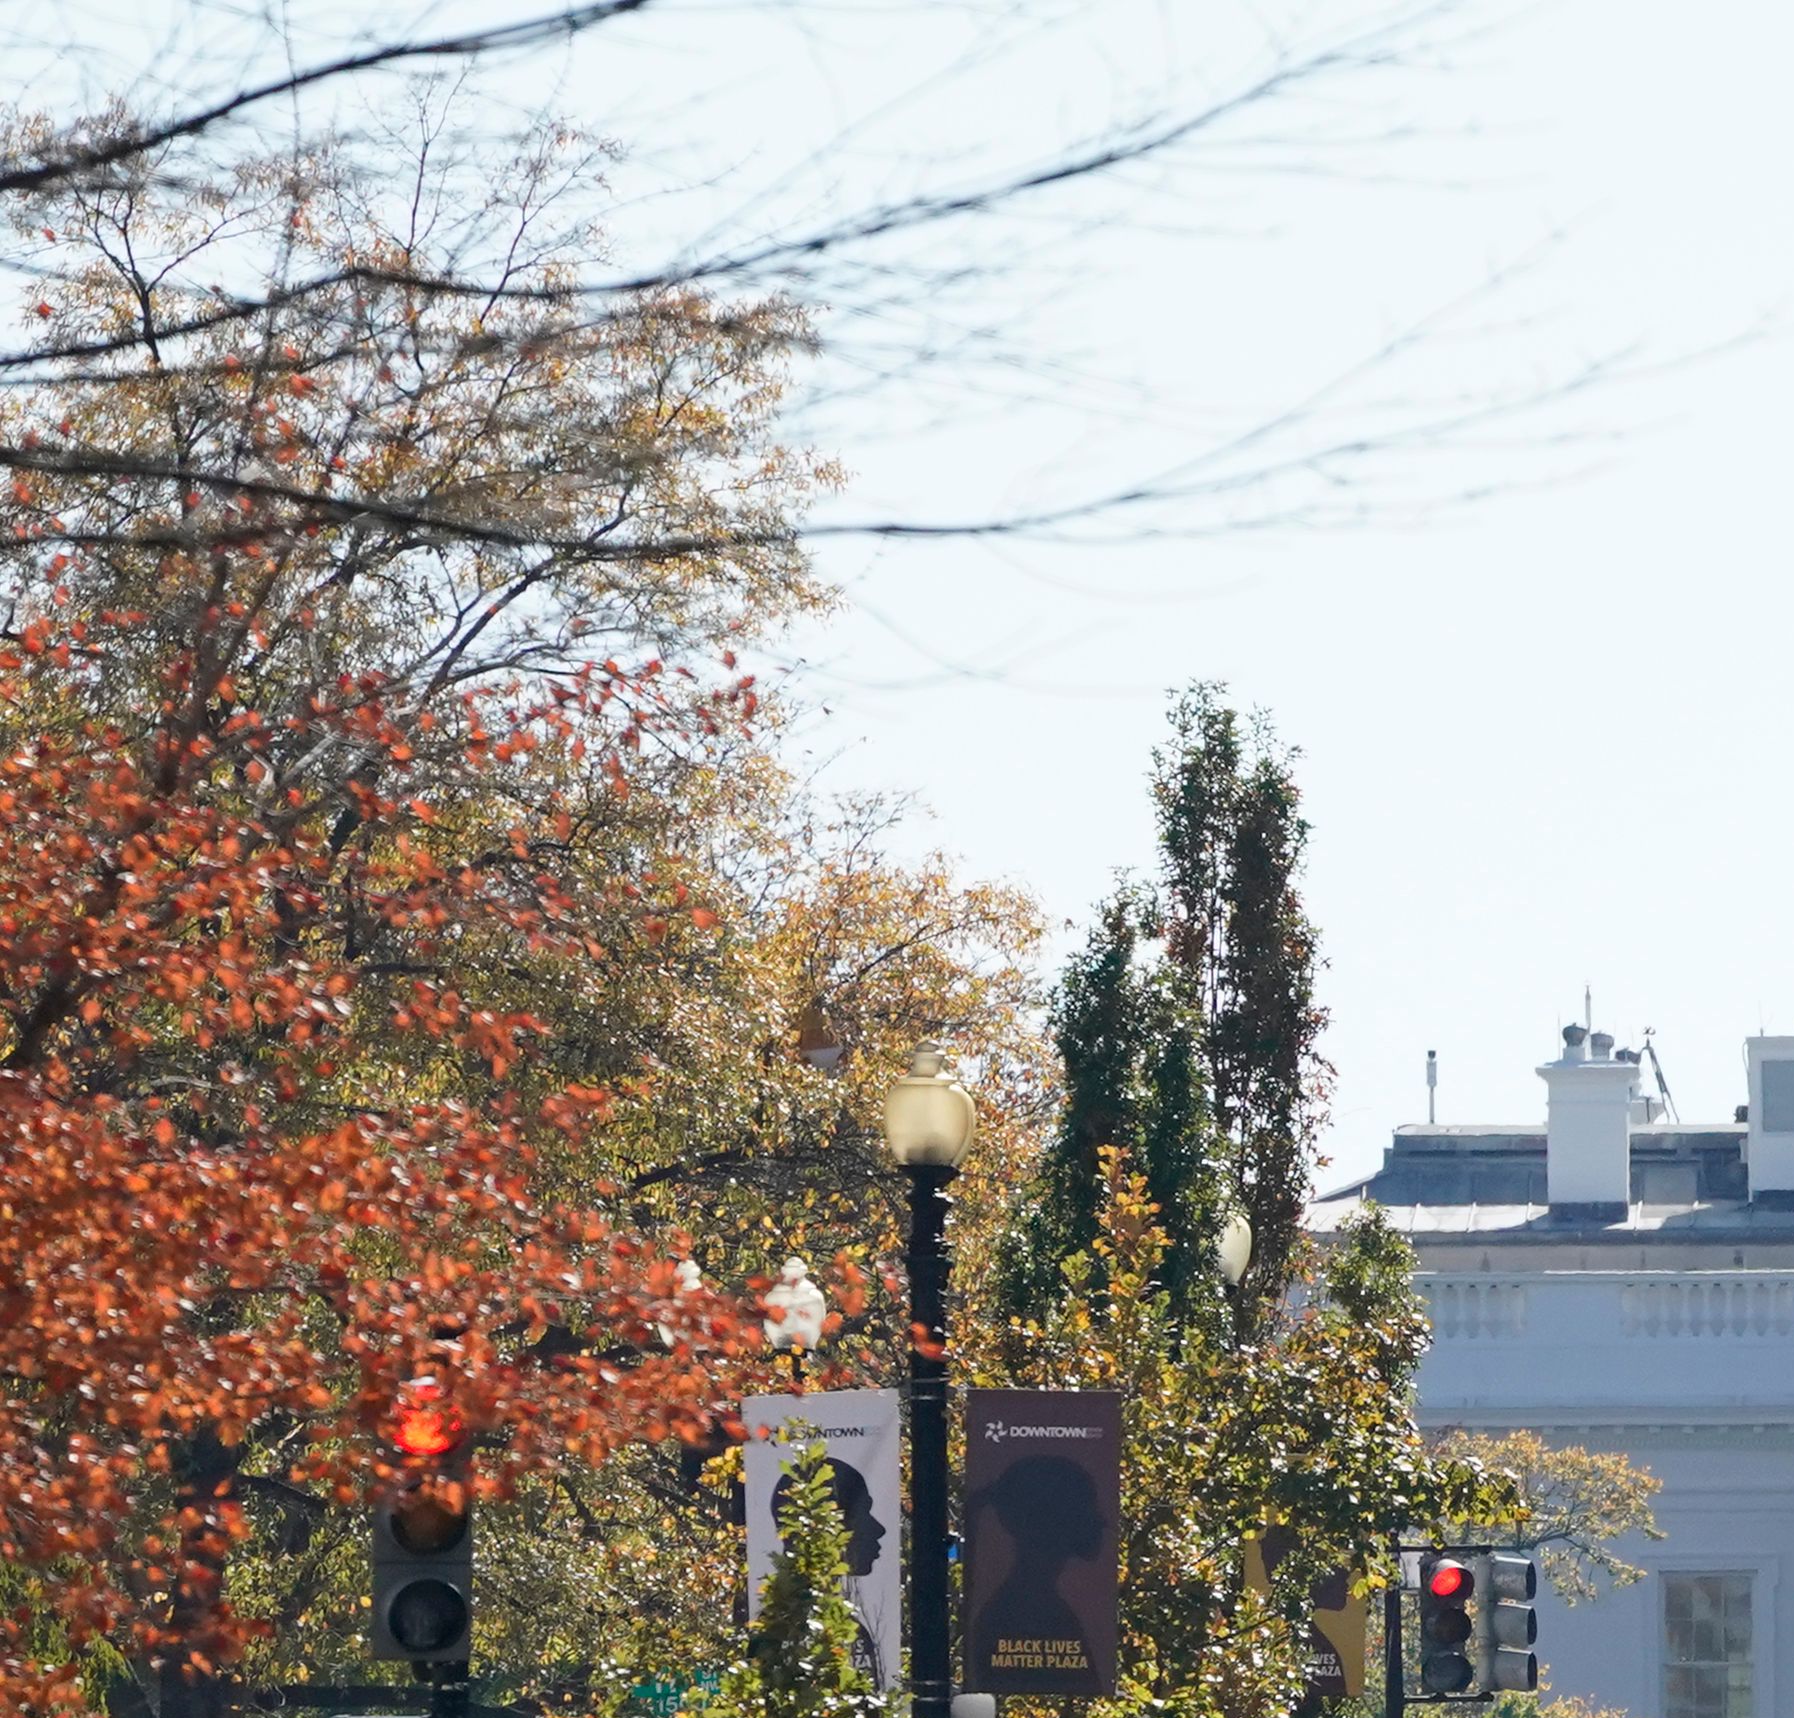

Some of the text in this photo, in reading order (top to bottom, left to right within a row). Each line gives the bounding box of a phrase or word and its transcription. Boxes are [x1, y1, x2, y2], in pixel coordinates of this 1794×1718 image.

[1010, 1426, 1087, 1439] DOWNTOWN
[998, 1639, 1080, 1654] BLACK LIVES
[991, 1654, 1088, 1669] MATTER PLAZA
